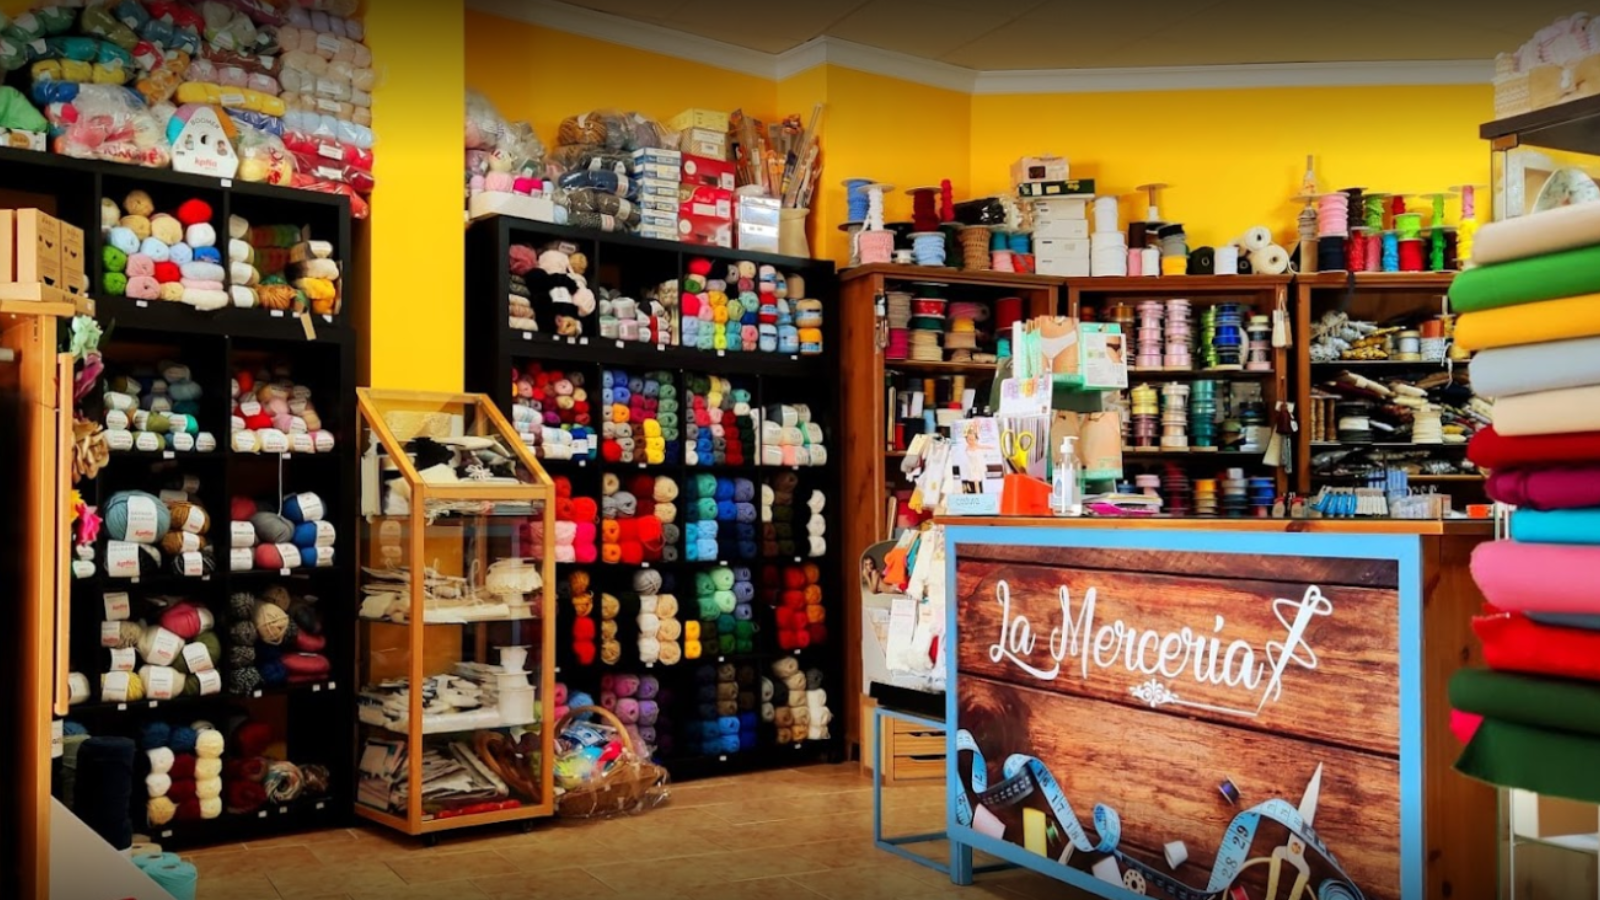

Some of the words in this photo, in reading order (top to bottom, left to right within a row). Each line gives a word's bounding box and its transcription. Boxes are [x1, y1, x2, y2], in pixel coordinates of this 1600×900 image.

[190, 117, 220, 129] BOOMER
[989, 580, 1060, 681] La
[1050, 584, 1264, 690] Mercería
[1233, 824, 1249, 850] 29
[1221, 856, 1238, 880] 28
